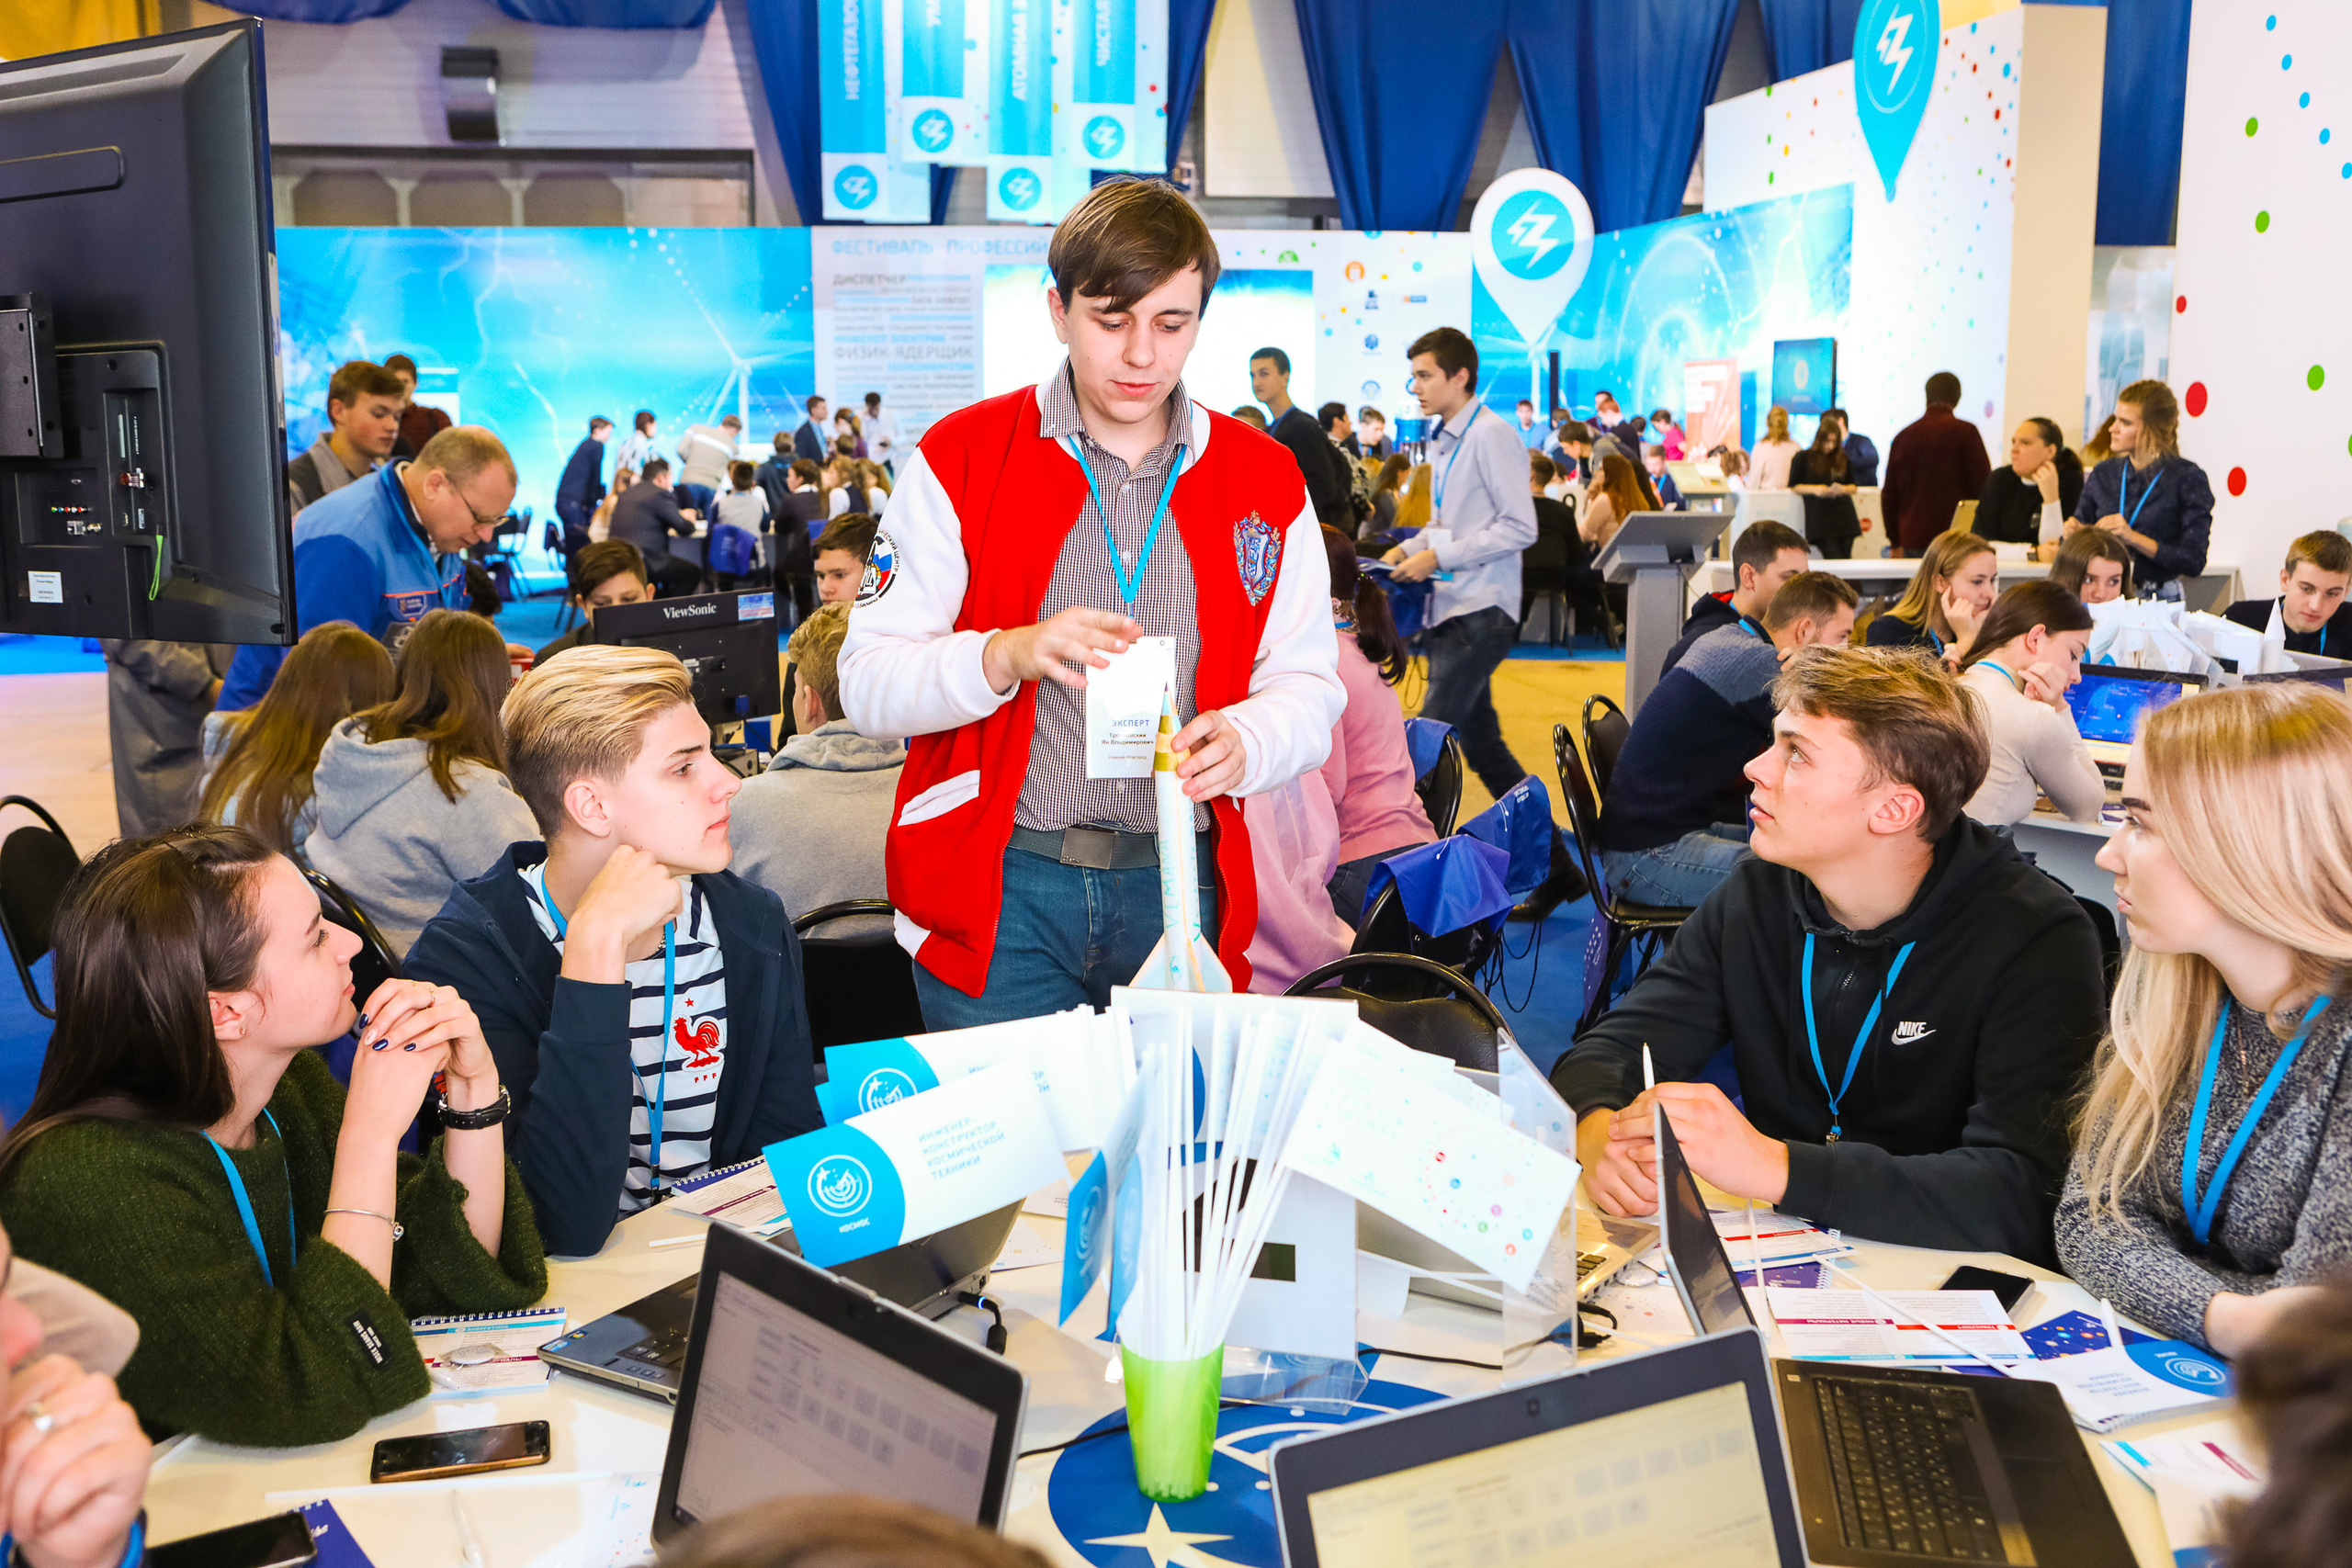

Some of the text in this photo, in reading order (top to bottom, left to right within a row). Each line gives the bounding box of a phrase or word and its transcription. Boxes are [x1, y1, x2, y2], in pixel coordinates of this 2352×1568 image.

[831, 240, 933, 254] ФЕСТИВАЛЬ
[832, 274, 907, 286] ДИСПЕТЧЕР
[834, 345, 974, 360] ФИЗИК-ЯДЕРЩИК
[663, 603, 717, 619] ViewSonic
[1897, 1021, 1928, 1036] NIKE
[922, 1121, 997, 1155] КОНСТРУКТОР
[926, 1129, 1006, 1168] КОСМИЧЕСКОЙ
[931, 1156, 982, 1180] ТЕХНИКИ
